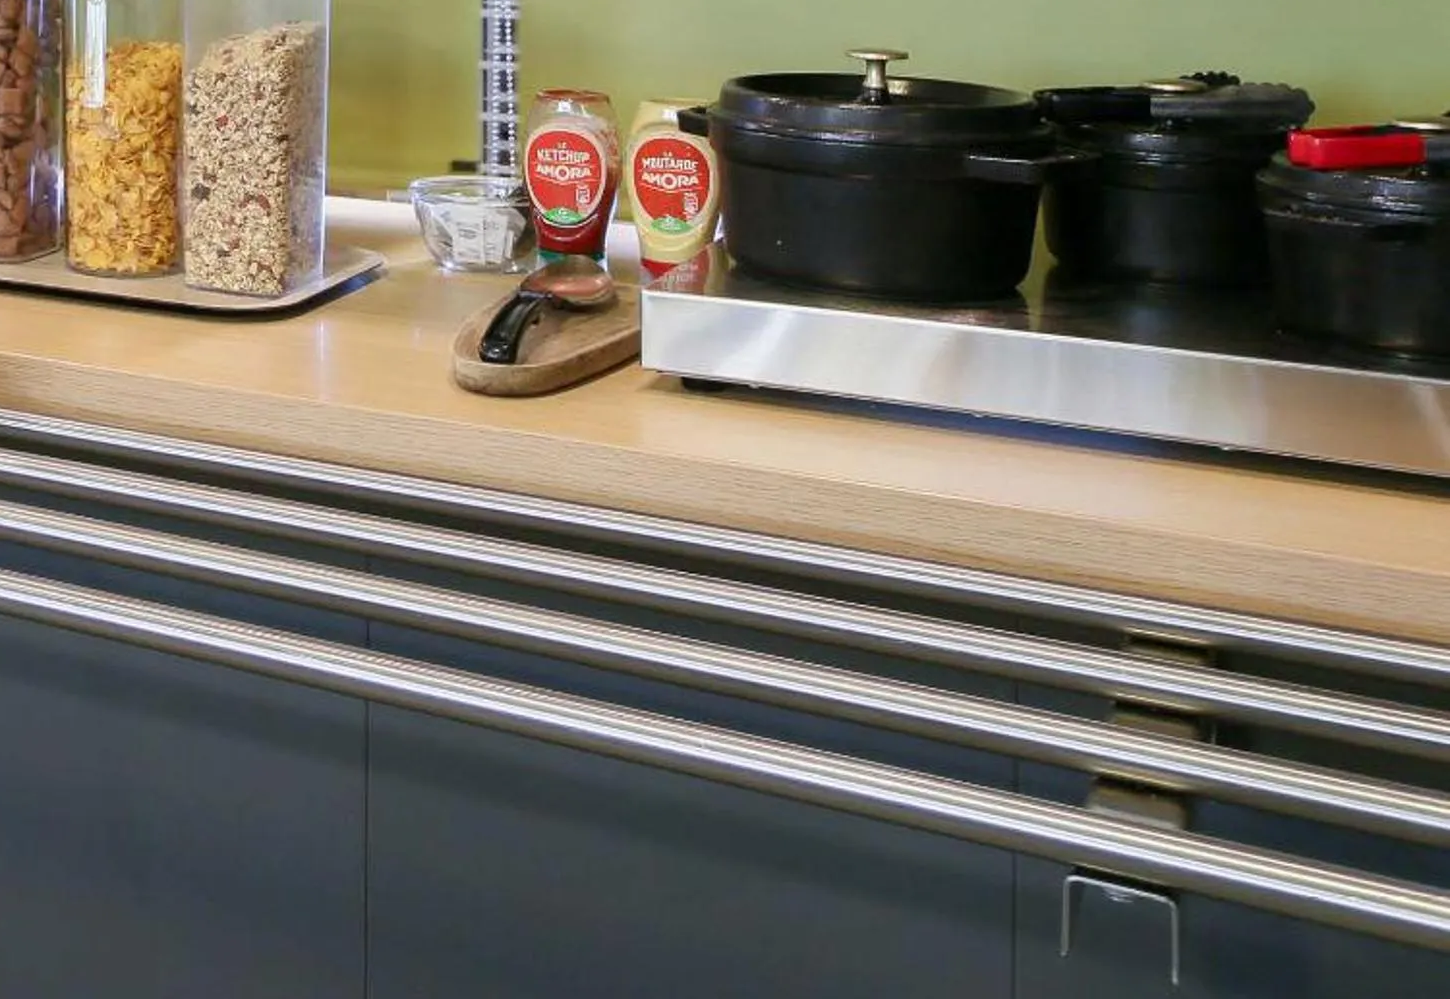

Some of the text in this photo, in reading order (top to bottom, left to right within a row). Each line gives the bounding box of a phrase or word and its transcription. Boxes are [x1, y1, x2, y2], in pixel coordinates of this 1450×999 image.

[536, 148, 591, 163] KETCHUP
[641, 156, 699, 171] MOUTARDE
[535, 165, 591, 181] AMORA
[641, 172, 700, 190] AMORA
